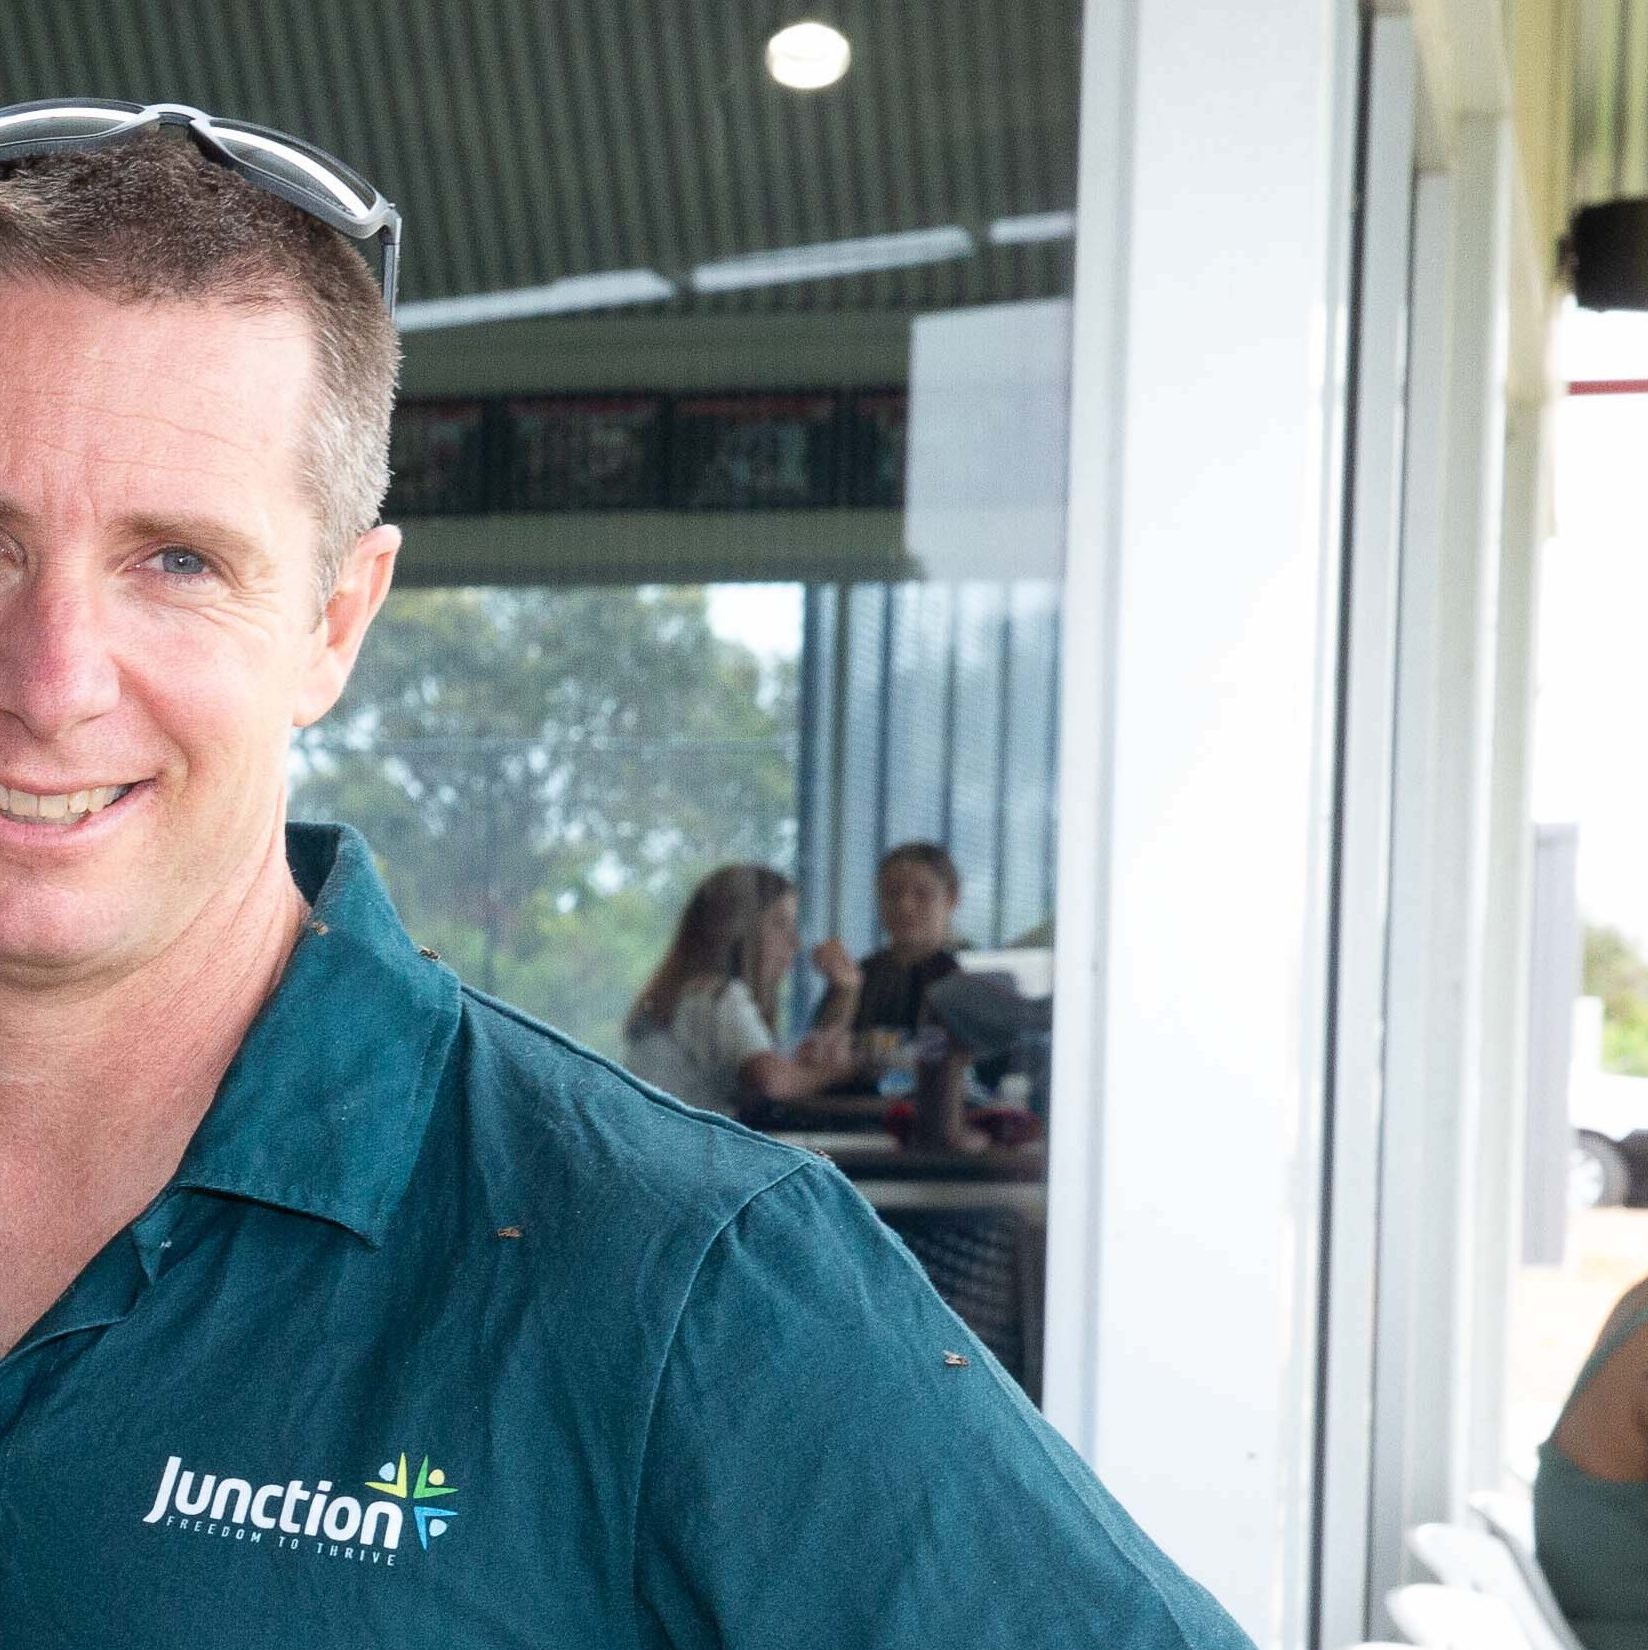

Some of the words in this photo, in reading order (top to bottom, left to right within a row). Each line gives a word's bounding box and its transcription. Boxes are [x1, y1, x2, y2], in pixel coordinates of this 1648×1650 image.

[143, 1455, 404, 1549] Junction
[166, 1515, 262, 1543] FREEDOM
[278, 1536, 299, 1549] TO
[316, 1541, 397, 1566] THRIVE
